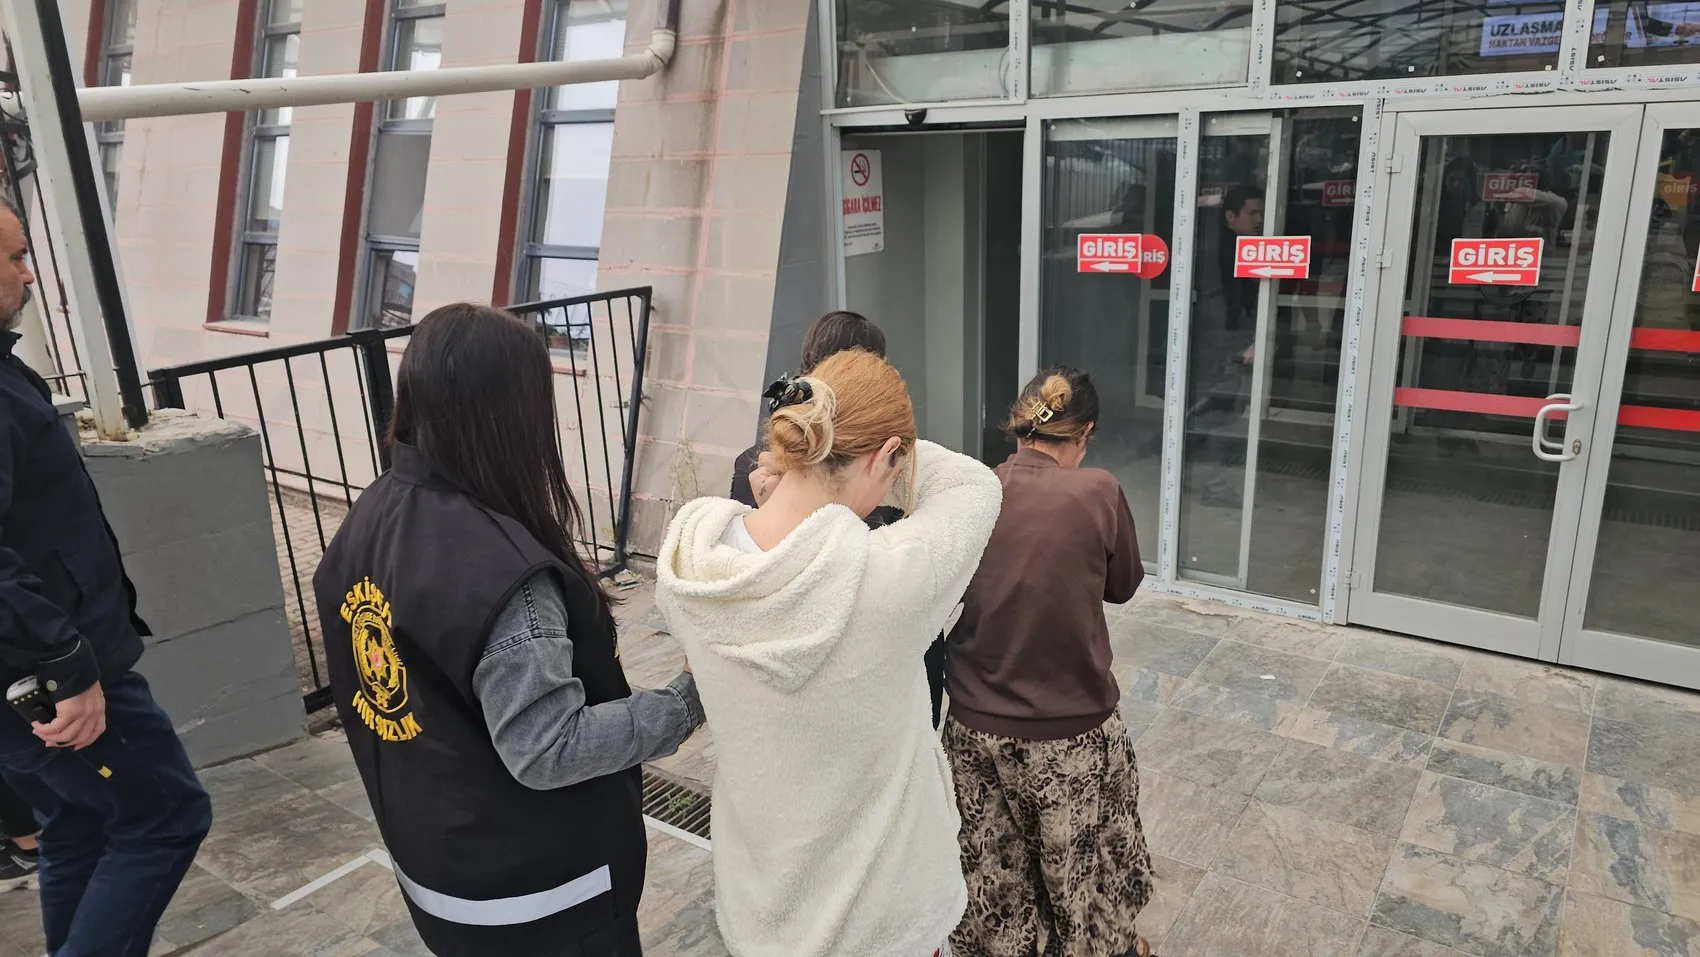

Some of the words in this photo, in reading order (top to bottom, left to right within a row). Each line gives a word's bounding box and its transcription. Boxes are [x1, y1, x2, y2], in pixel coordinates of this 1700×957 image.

[1083, 237, 1137, 260] GİRİŞ
[1241, 241, 1305, 264] GİRİŞ
[1457, 243, 1535, 268] GİRİŞ
[352, 690, 423, 742] HIRSIZLIK
